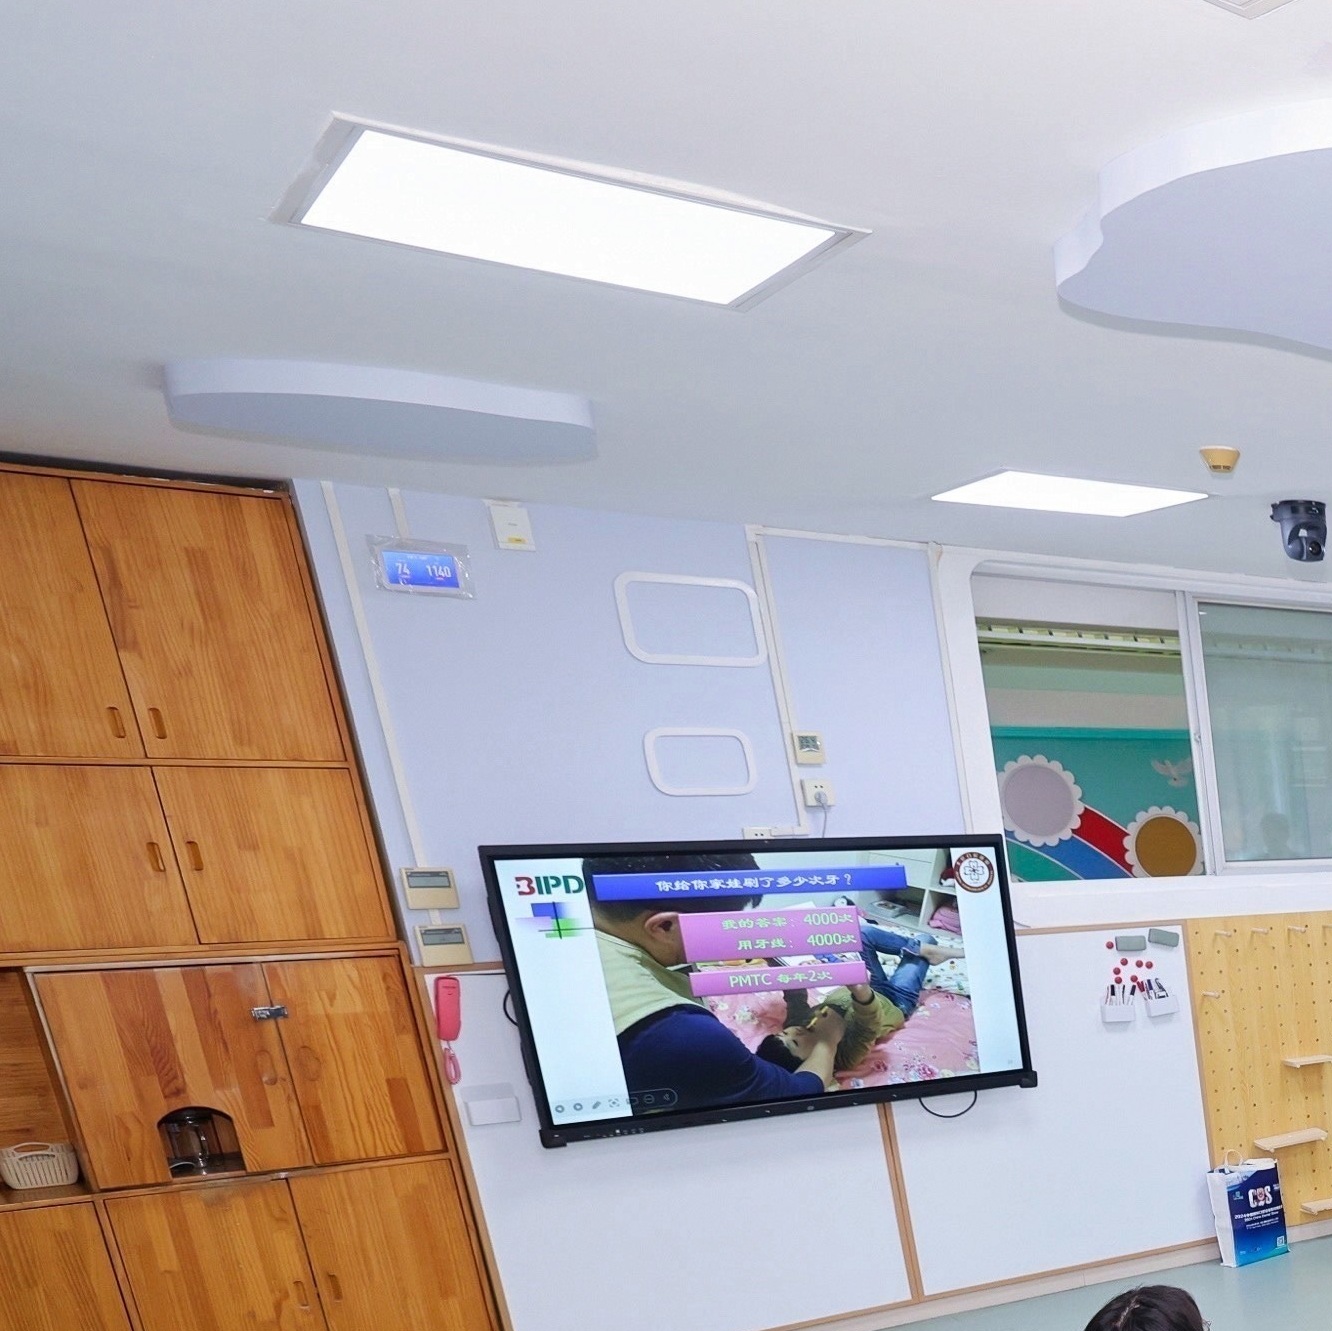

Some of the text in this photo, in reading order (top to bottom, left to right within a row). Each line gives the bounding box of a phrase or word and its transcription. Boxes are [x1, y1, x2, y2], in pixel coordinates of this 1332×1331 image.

[395, 562, 452, 578] 74 1140
[515, 875, 584, 896] BIPD
[729, 972, 772, 988] PMTC
